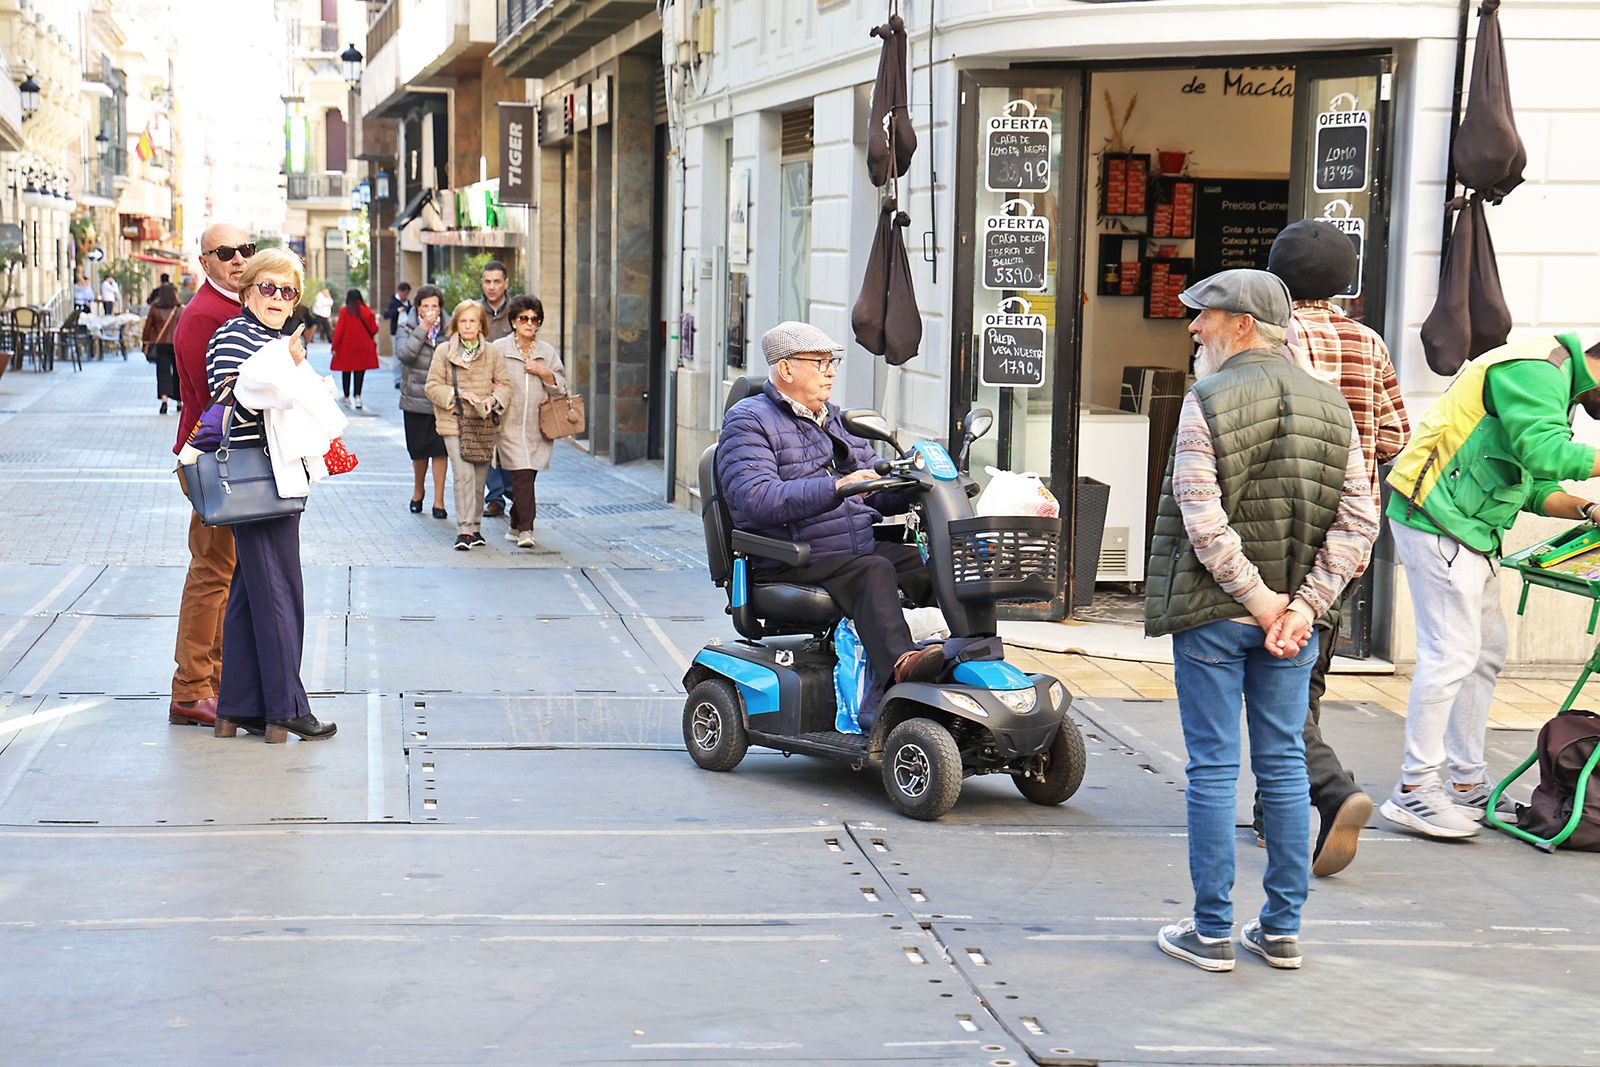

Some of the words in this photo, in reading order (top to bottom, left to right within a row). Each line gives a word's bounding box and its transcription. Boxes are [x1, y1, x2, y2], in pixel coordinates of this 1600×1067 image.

[1181, 75, 1206, 94] de
[1319, 112, 1367, 126] OFERTA
[991, 119, 1048, 130] OFERTA
[1020, 135, 1030, 145] DE
[508, 121, 523, 187] TIGER
[1024, 145, 1047, 154] NEGRA
[1325, 146, 1357, 162] LOMO
[1222, 200, 1256, 210] Precios
[987, 218, 1045, 230] OFERTA
[1222, 226, 1242, 234] Cinta
[1245, 226, 1255, 234] de
[1257, 226, 1279, 234] Lomo
[1020, 234, 1031, 243] DE
[1222, 237, 1248, 245] Cabeza
[1250, 237, 1259, 245] de
[1024, 246, 1036, 255] DE
[1221, 248, 1245, 257] Carne
[992, 257, 1024, 267] BELLOTA
[1221, 259, 1256, 268] Carrillera
[994, 267, 1033, 285] 53,90
[985, 315, 1043, 327] OFERTA
[988, 328, 1016, 346] PALETA
